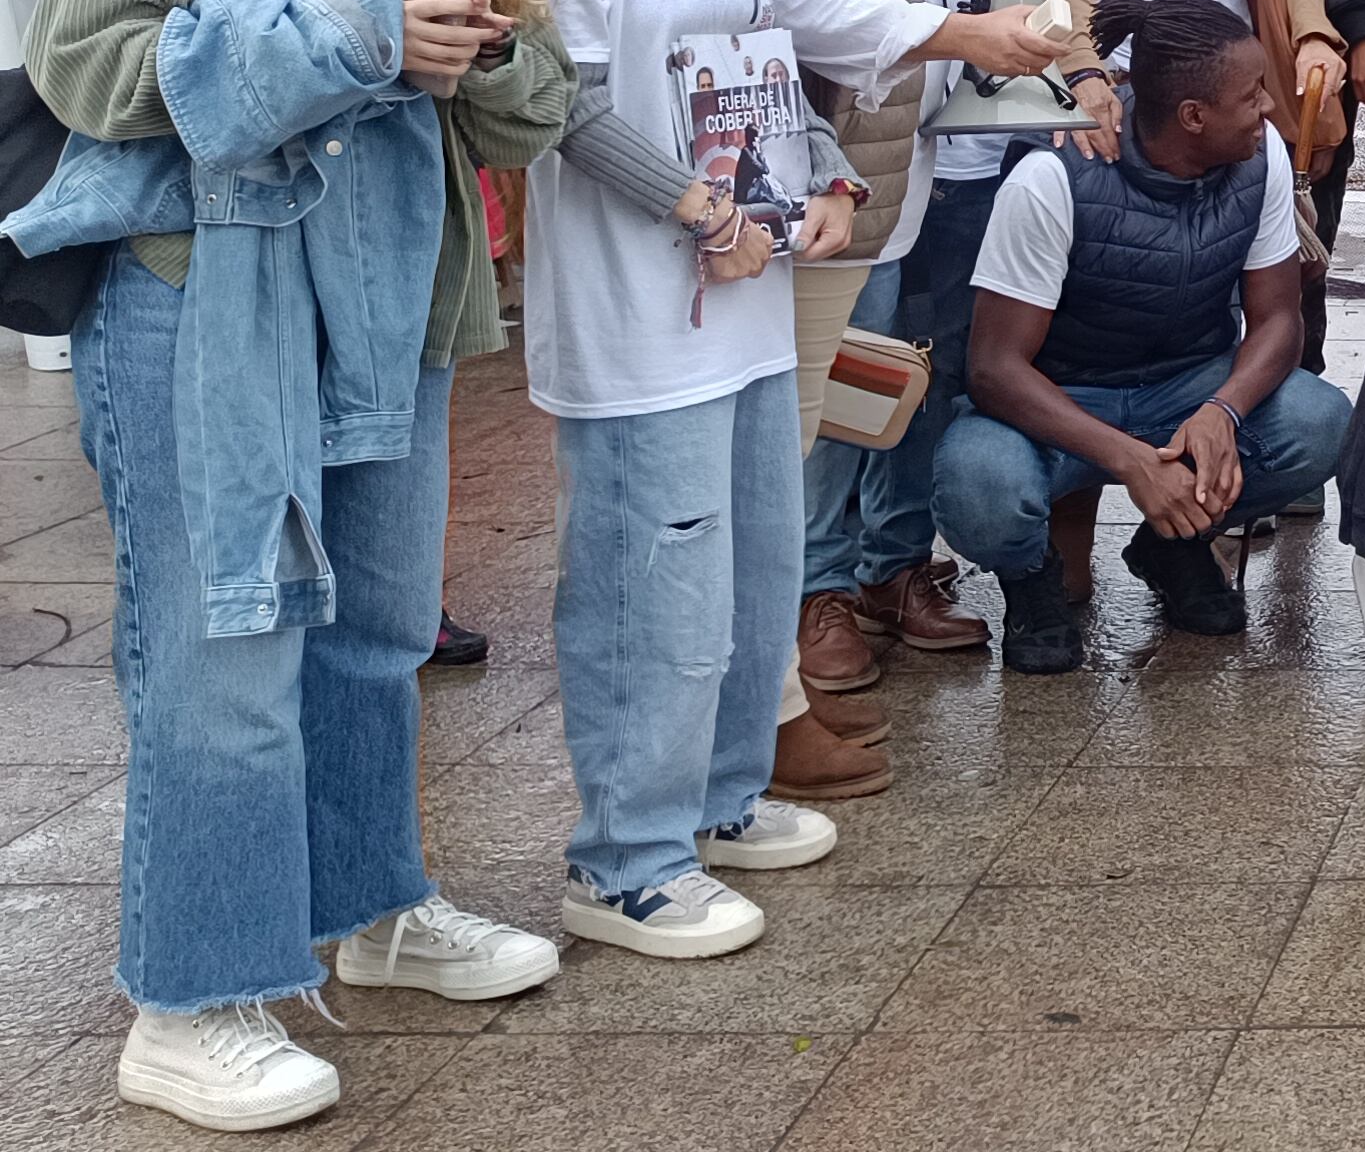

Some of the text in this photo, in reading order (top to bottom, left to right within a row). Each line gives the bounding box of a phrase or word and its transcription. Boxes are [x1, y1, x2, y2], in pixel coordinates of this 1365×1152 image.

[718, 90, 776, 113] FUERA DE
[705, 106, 792, 135] COBERTURA
